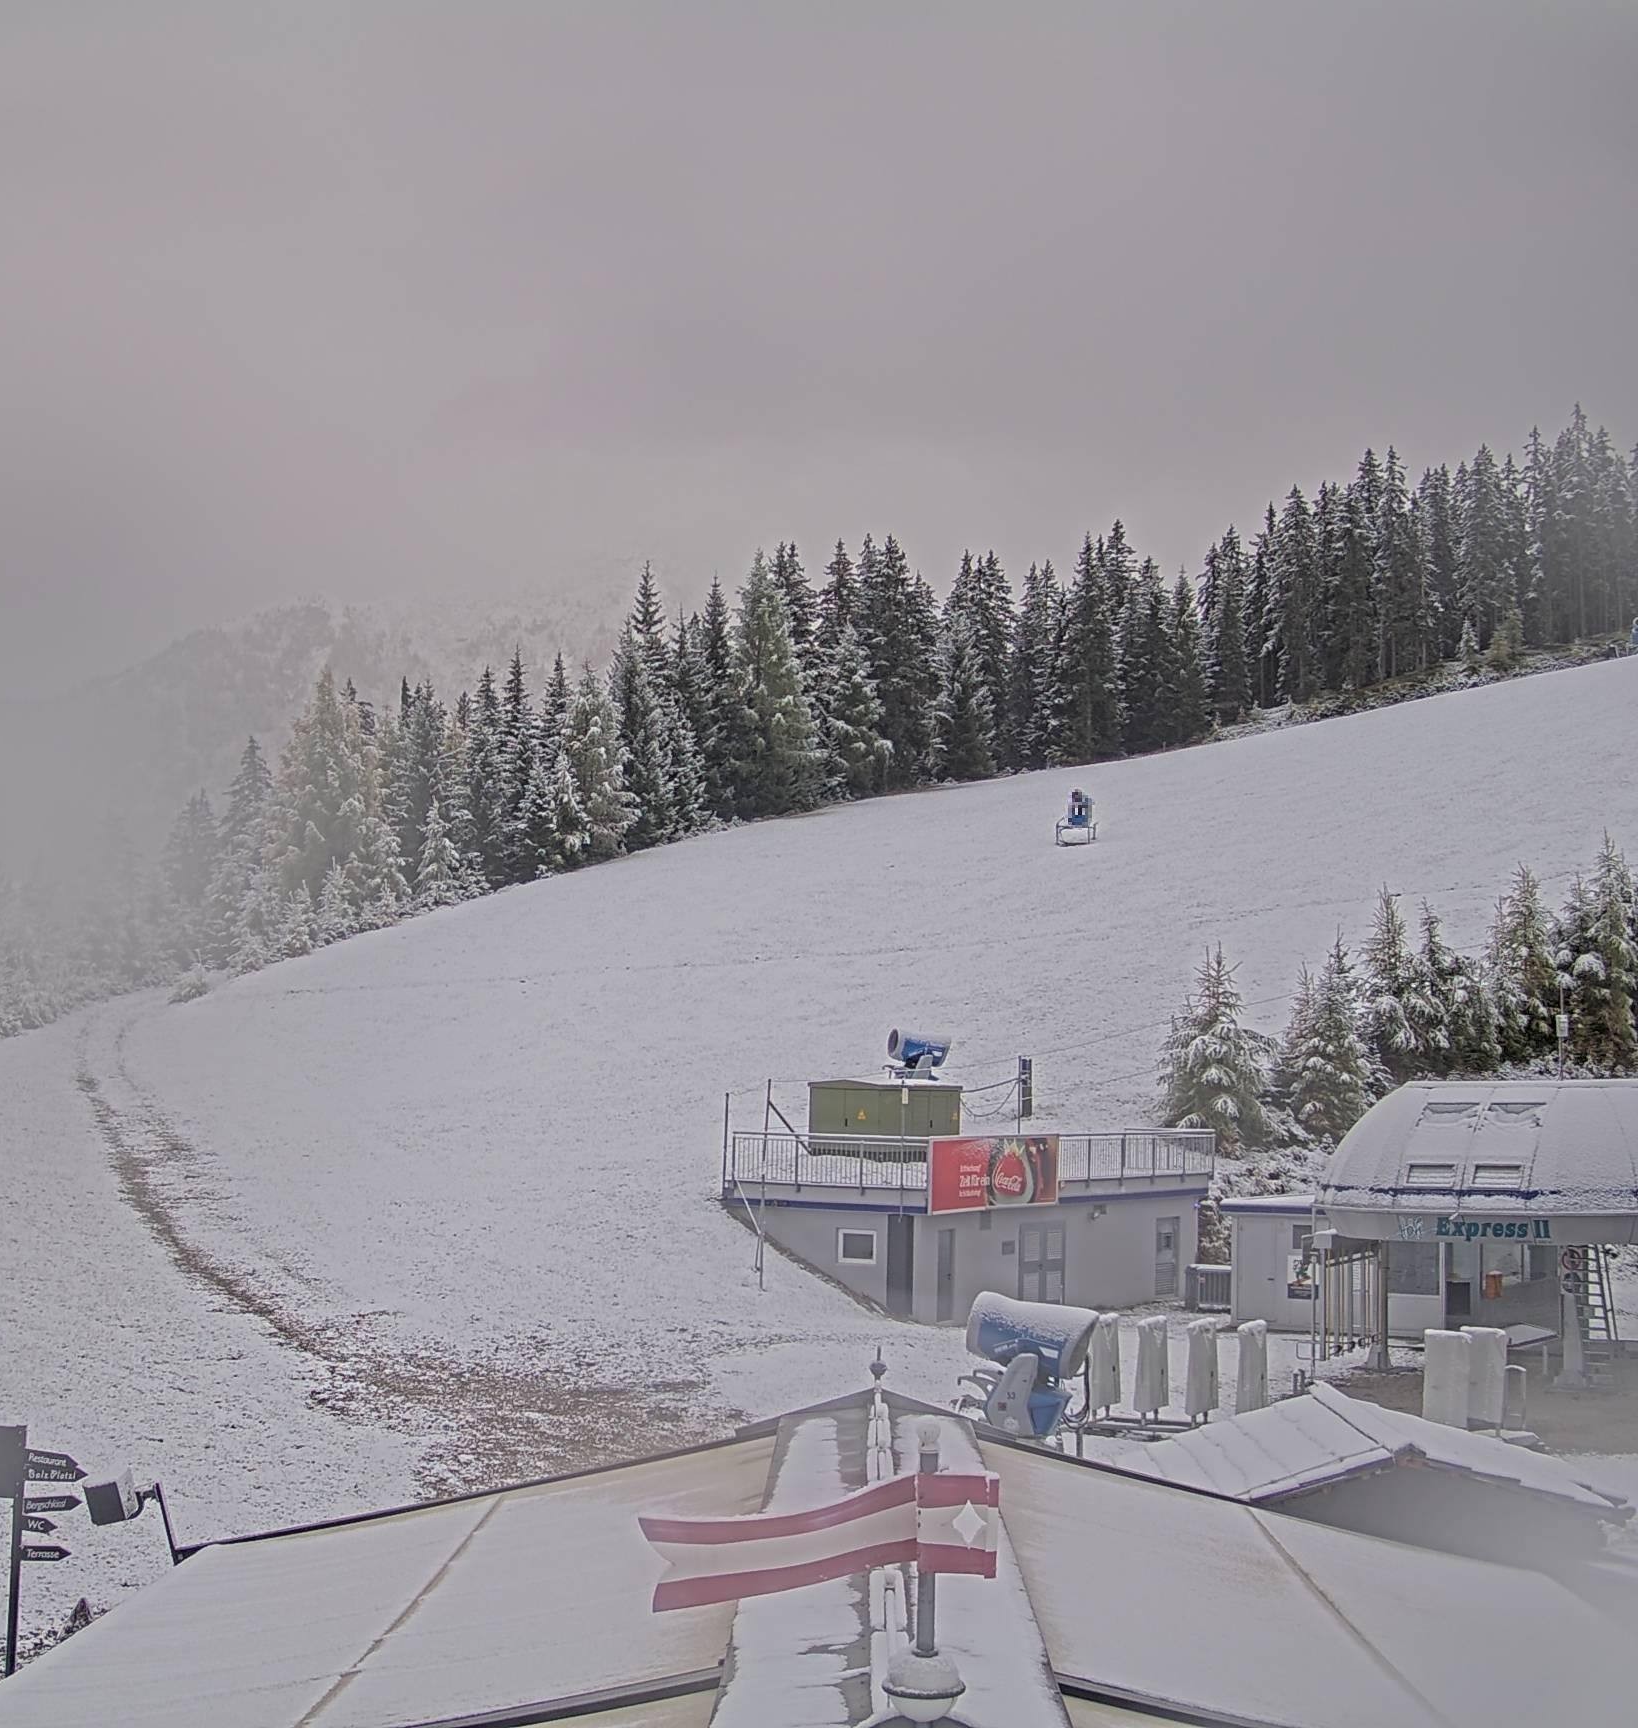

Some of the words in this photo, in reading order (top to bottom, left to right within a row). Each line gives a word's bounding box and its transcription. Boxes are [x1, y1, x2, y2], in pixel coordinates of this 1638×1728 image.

[1436, 1216, 1529, 1242] Express
[1533, 1219, 1551, 1239] II
[28, 1452, 67, 1467] Restaurant
[28, 1520, 46, 1530] WC
[26, 1549, 60, 1559] Terrasse
